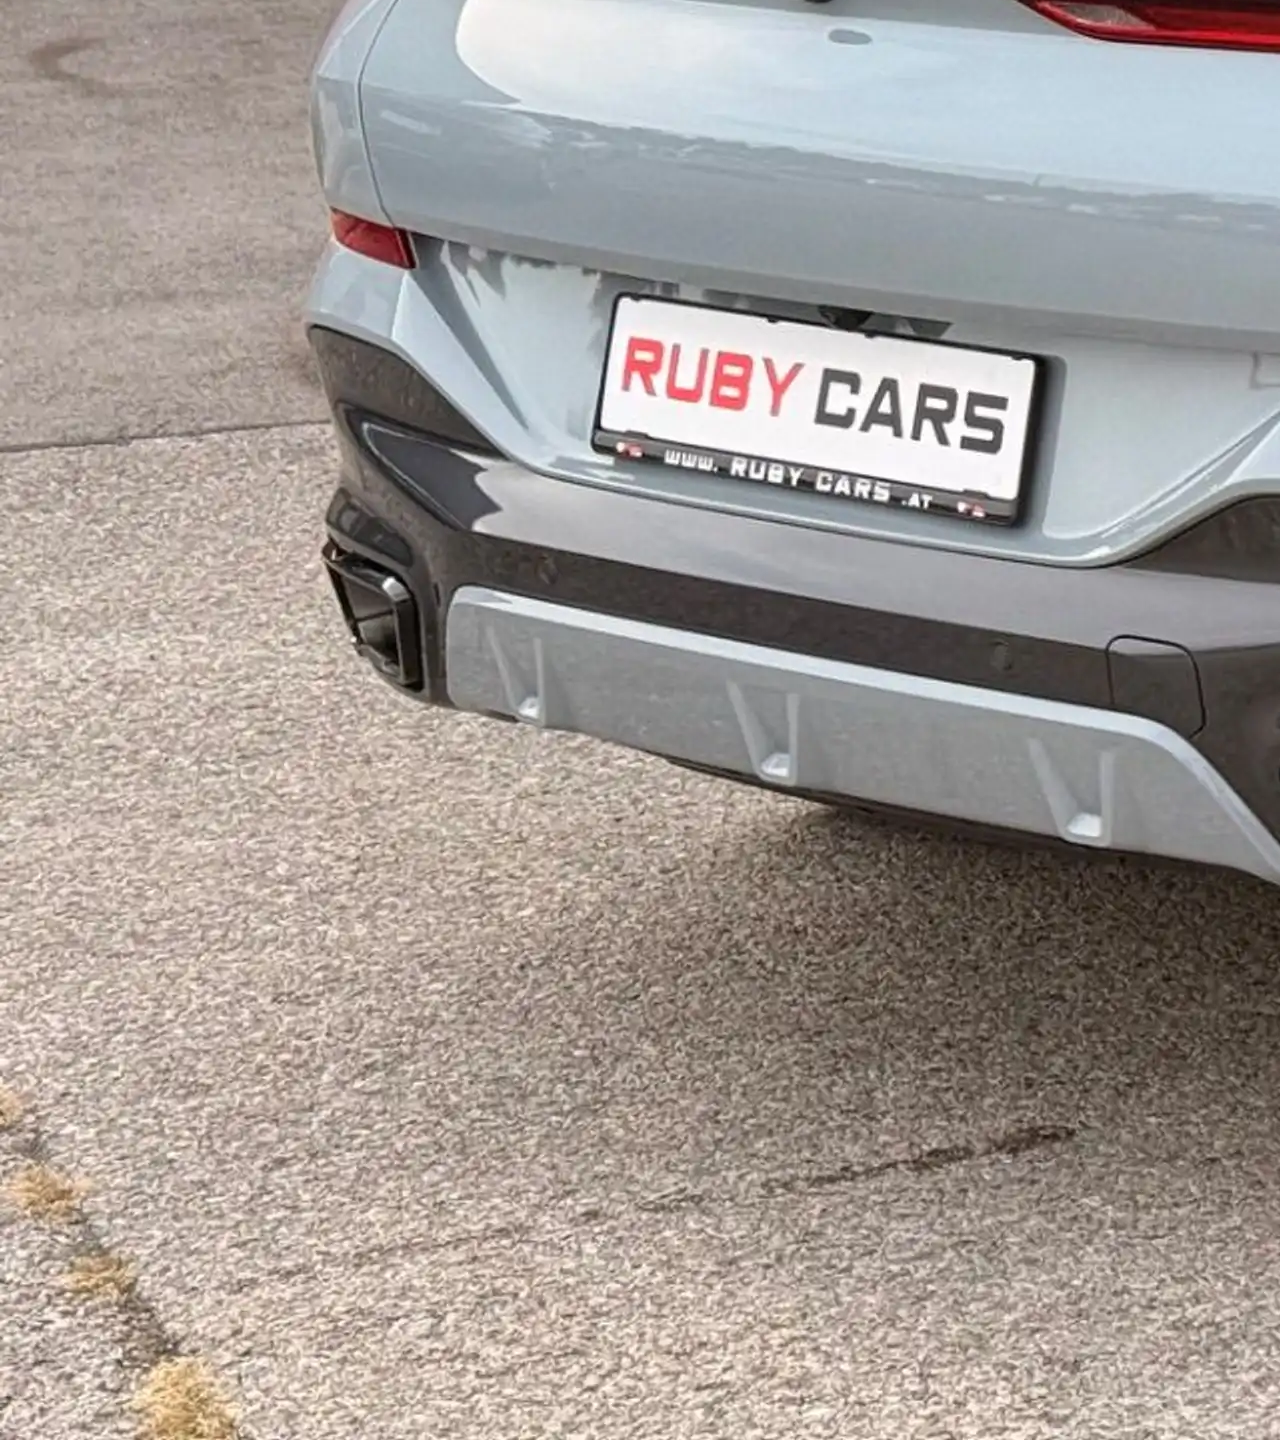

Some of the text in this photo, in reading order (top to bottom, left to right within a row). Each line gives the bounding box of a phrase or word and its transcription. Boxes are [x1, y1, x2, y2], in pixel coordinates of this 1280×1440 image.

[621, 336, 1010, 456] RUBY CARS
[730, 458, 805, 486] RUBY
[815, 471, 891, 502] CARS
